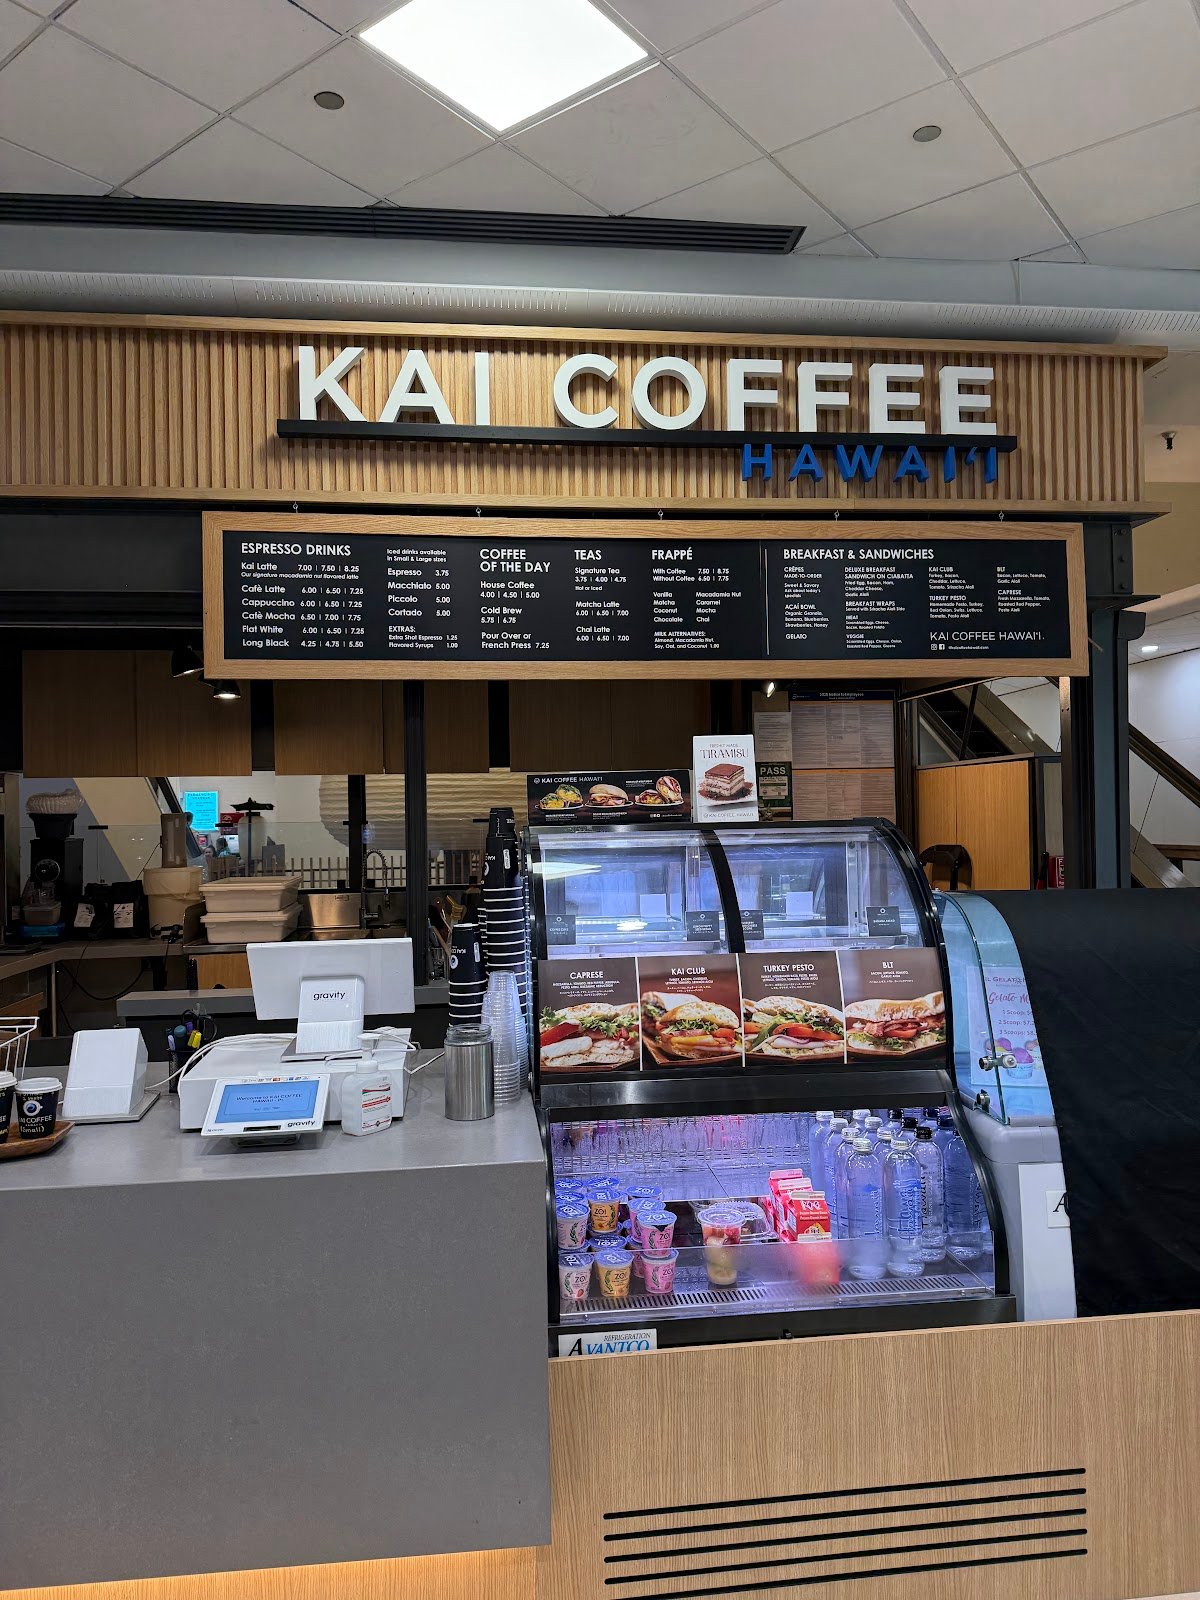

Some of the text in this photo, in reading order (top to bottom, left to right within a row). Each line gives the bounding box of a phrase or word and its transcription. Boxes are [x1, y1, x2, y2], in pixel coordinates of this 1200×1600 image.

[299, 346, 997, 436] KAI COFFEE
[242, 543, 351, 556] ESPRESSO DRINKS
[652, 547, 692, 560] FRAPPÉ
[784, 549, 934, 559] BREAKFAST & SANDWICHES
[480, 549, 526, 560] COFFEE
[574, 550, 602, 560] TEAS
[241, 562, 254, 570] Kai
[480, 561, 550, 572] OF THE DAY
[388, 568, 422, 577] Espresso
[575, 567, 606, 575] Signature
[388, 581, 432, 589] Macchiato
[242, 598, 295, 607] Cappuccino
[265, 612, 295, 620] Mocha
[259, 625, 283, 633] White
[930, 631, 995, 641] KAI COFFEE
[243, 639, 263, 648] Long
[700, 748, 749, 758] TIRAMISU
[760, 767, 786, 775] PASS
[314, 990, 346, 1001] gravity
[989, 992, 1018, 1004] Gelato
[26, 1115, 52, 1123] COFFEE
[287, 1120, 316, 1128] gravity
[604, 1333, 651, 1341] REFRIGERATION
